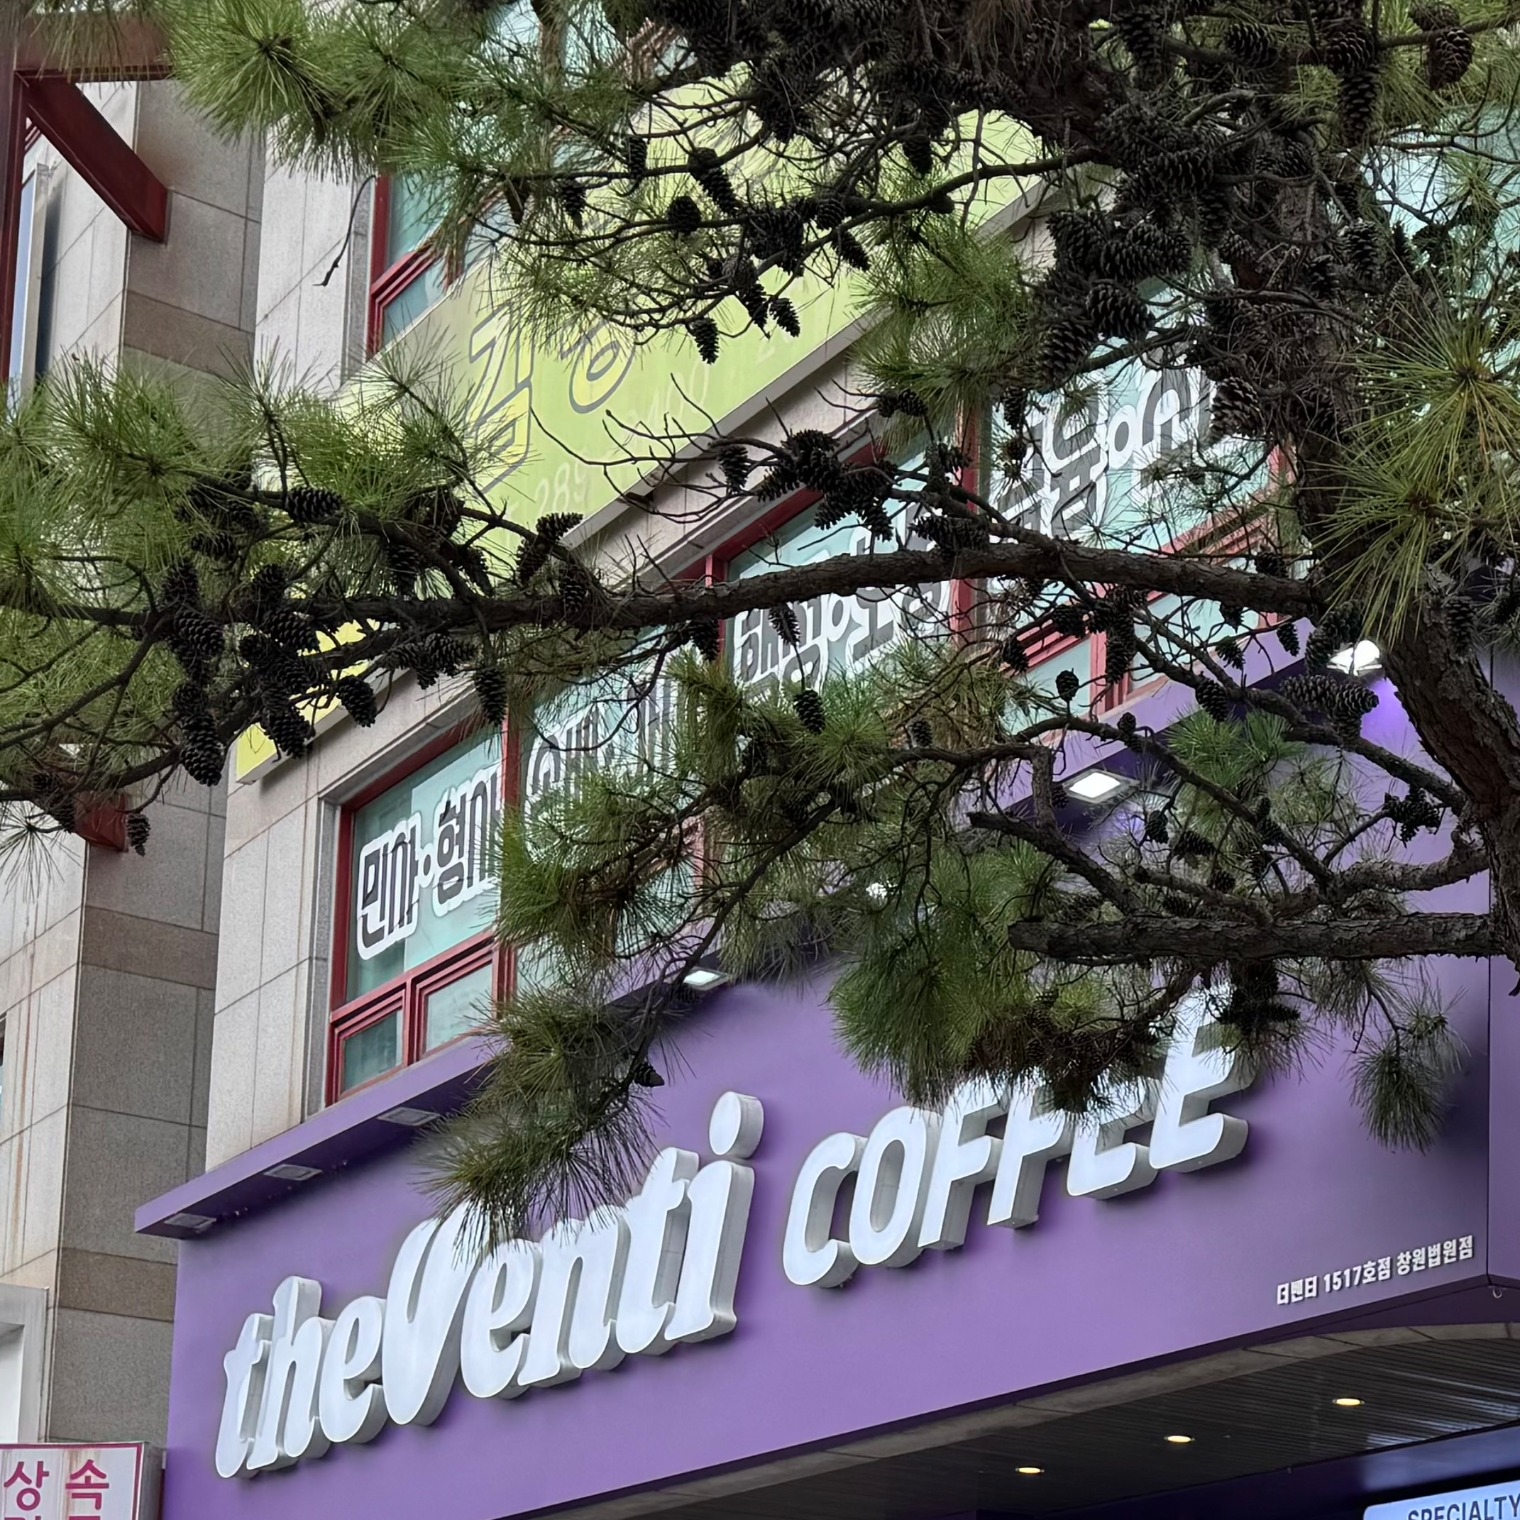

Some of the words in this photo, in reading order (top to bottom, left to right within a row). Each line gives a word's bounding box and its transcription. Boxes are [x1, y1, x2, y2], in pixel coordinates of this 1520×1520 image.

[216, 1090, 765, 1480] theVenti
[1323, 1256, 1391, 1293] 1517호점
[1396, 1235, 1474, 1276] 창원법원점
